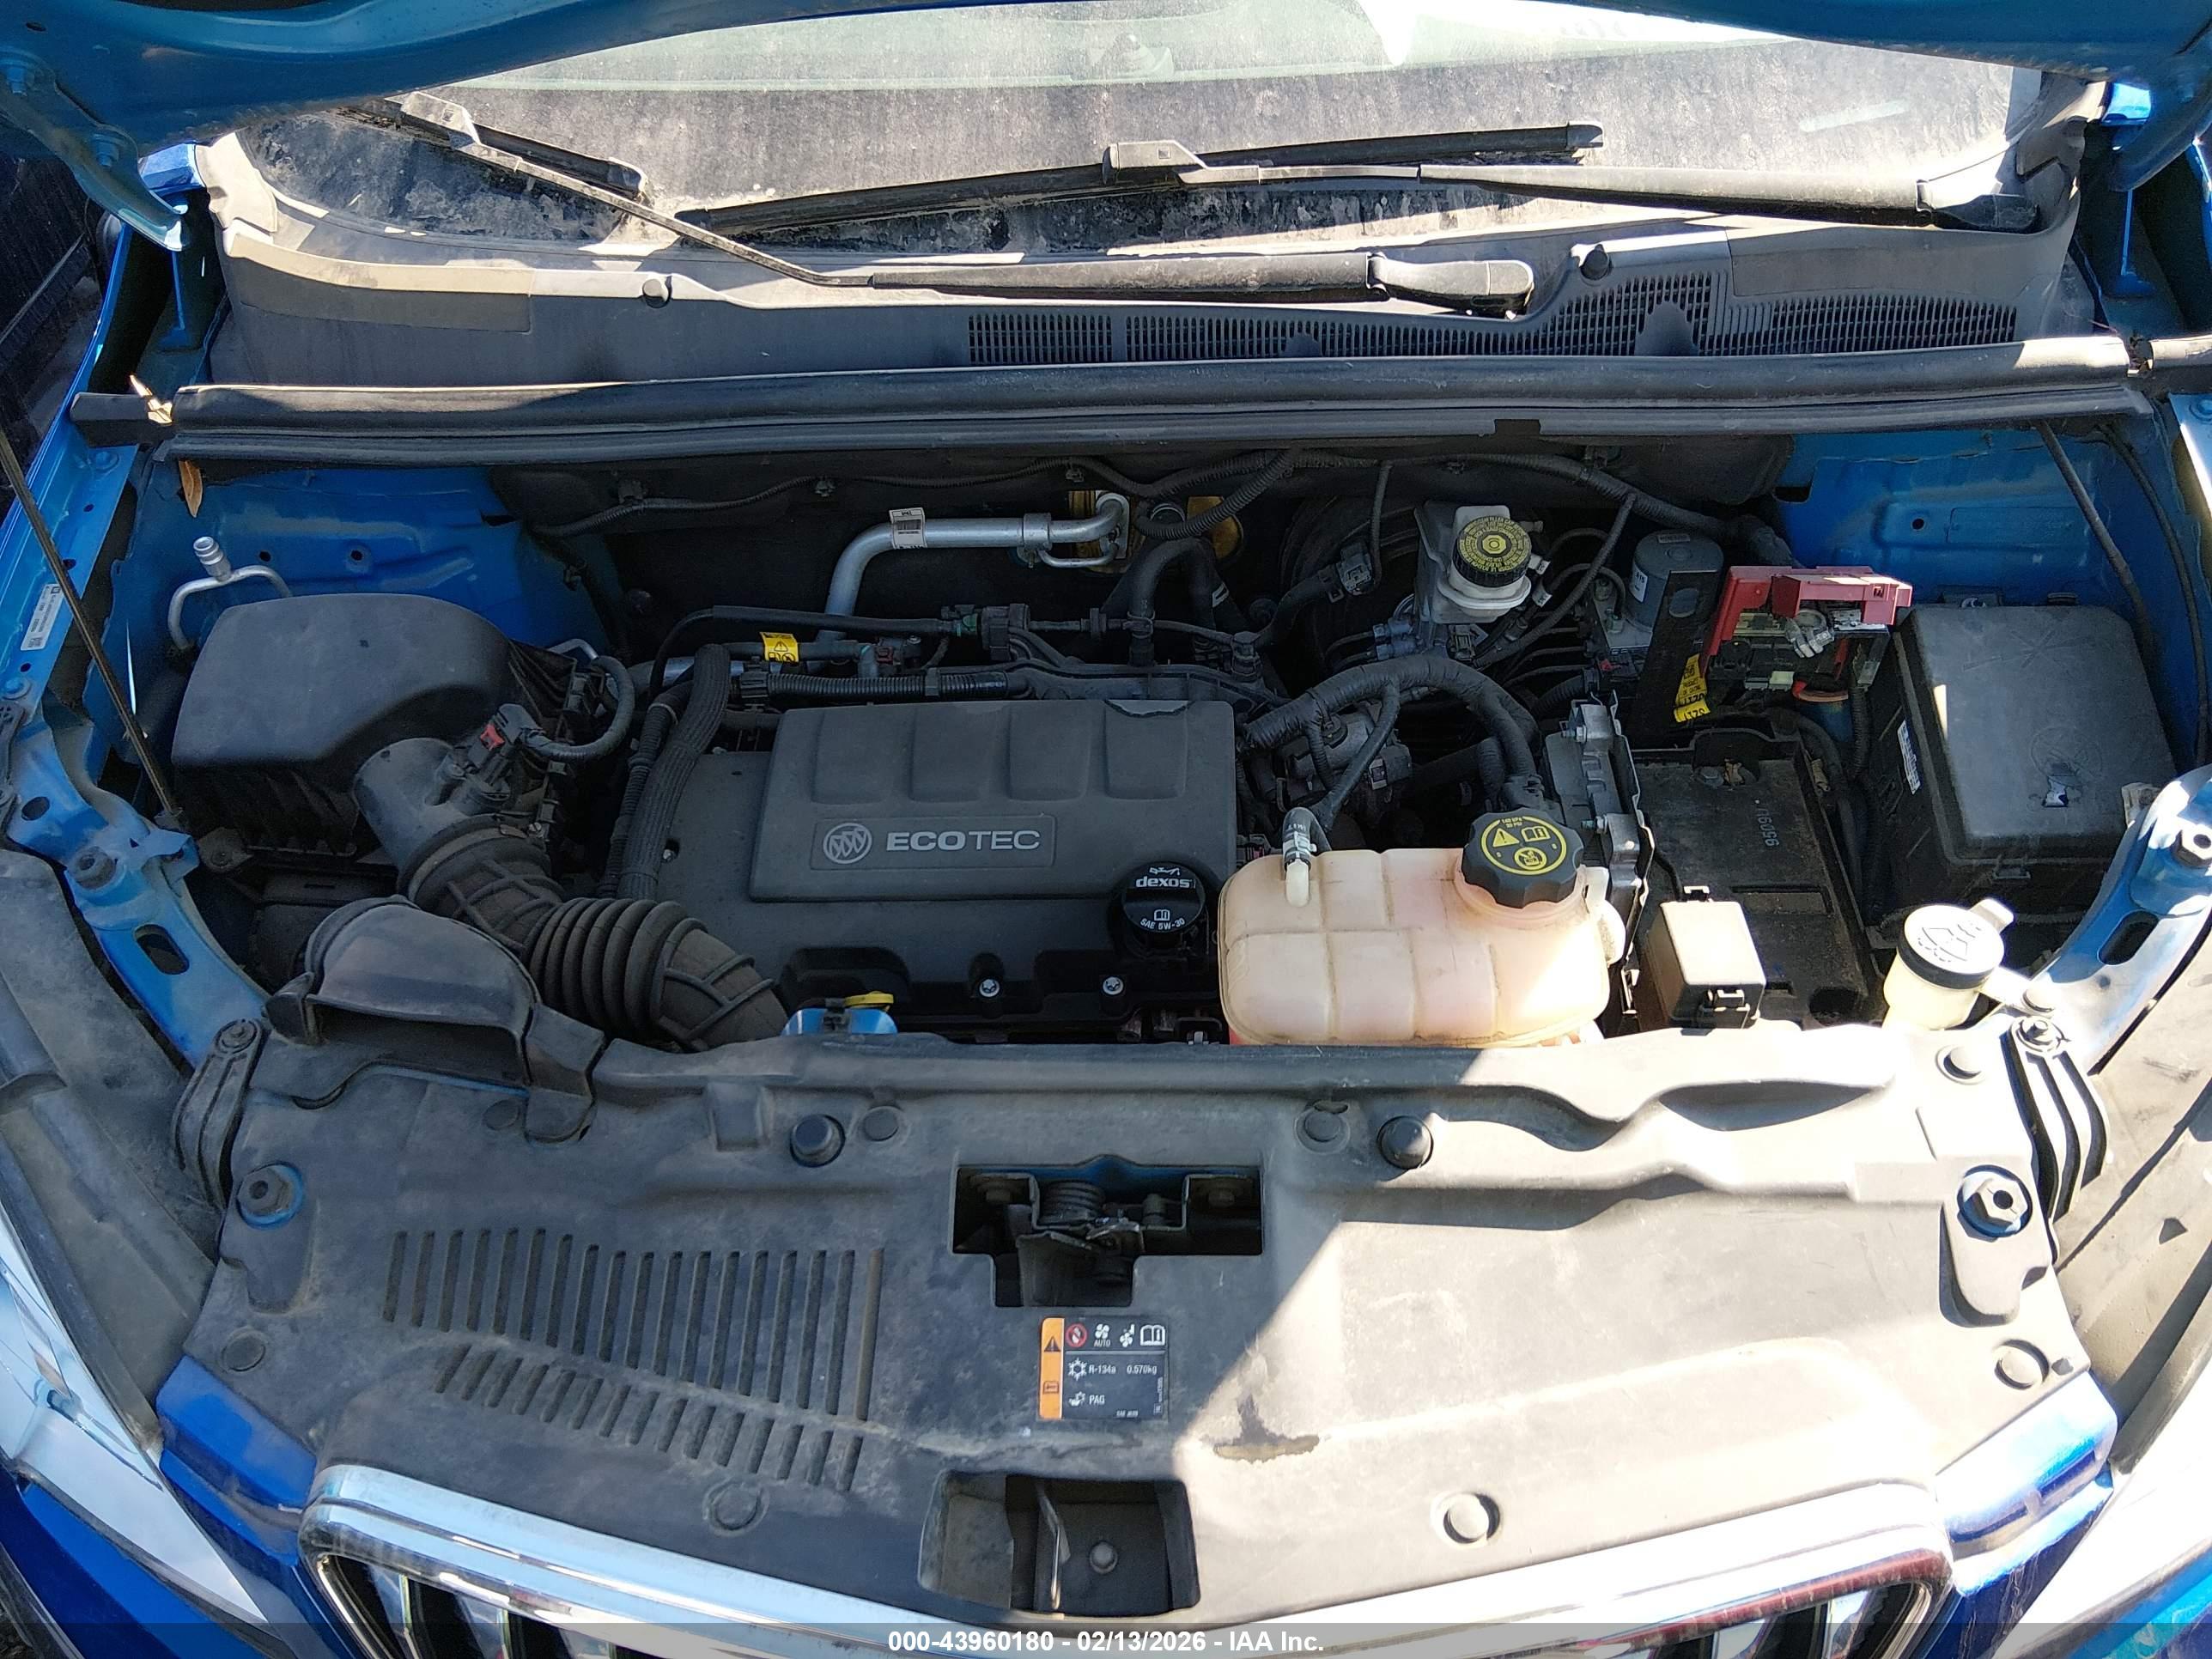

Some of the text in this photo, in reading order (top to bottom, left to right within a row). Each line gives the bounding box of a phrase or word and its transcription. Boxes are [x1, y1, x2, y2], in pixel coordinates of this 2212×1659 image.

[886, 830, 1041, 851] ECOTEC
[1140, 918, 1185, 930] SAE 5W-30
[1089, 1364, 1116, 1374] R-134a
[1089, 1395, 1105, 1405] PAG
